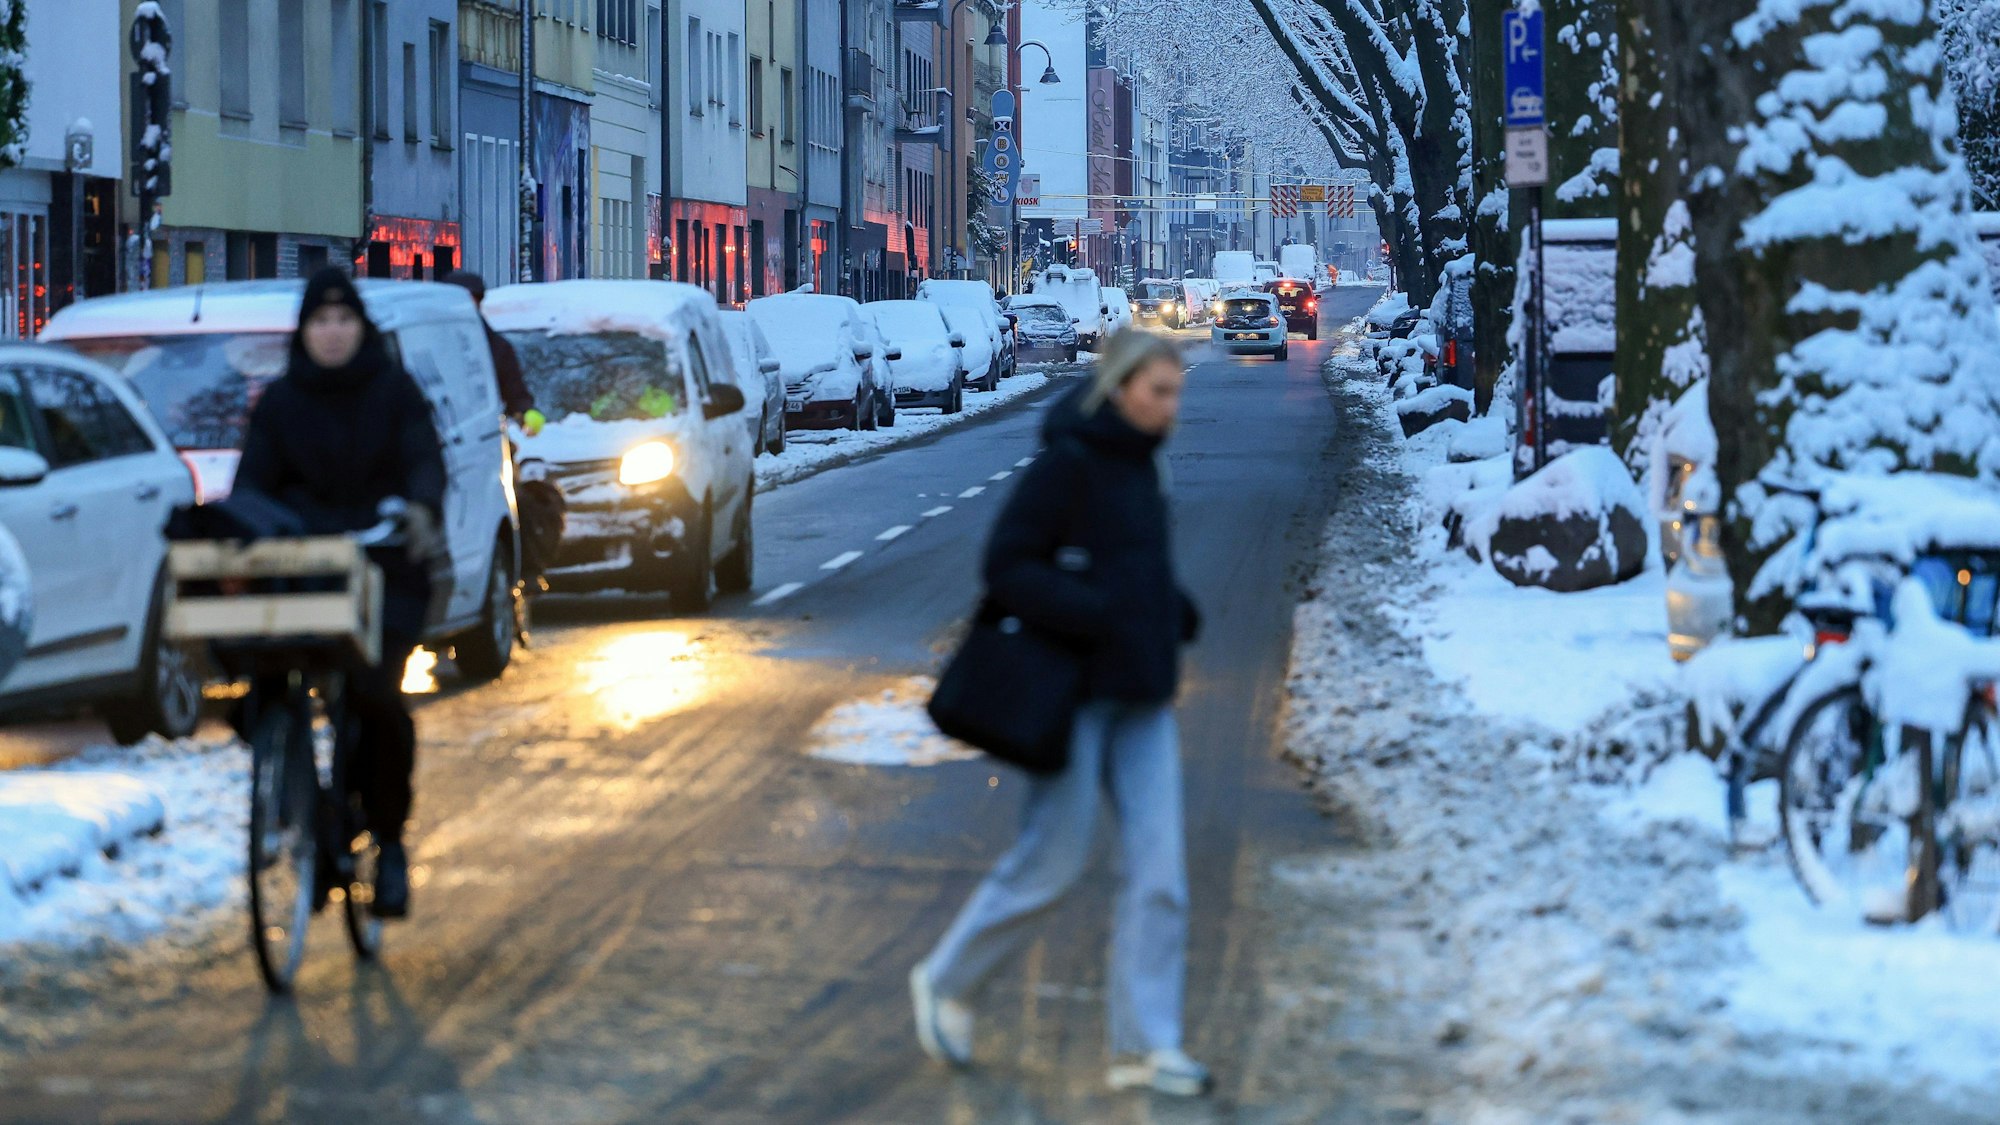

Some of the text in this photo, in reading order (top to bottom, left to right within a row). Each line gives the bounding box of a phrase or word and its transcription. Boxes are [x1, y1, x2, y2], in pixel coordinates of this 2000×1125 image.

[1508, 18, 1527, 64] P
[994, 138, 1010, 201] BOWL
[1016, 197, 1039, 206] KIOSK
